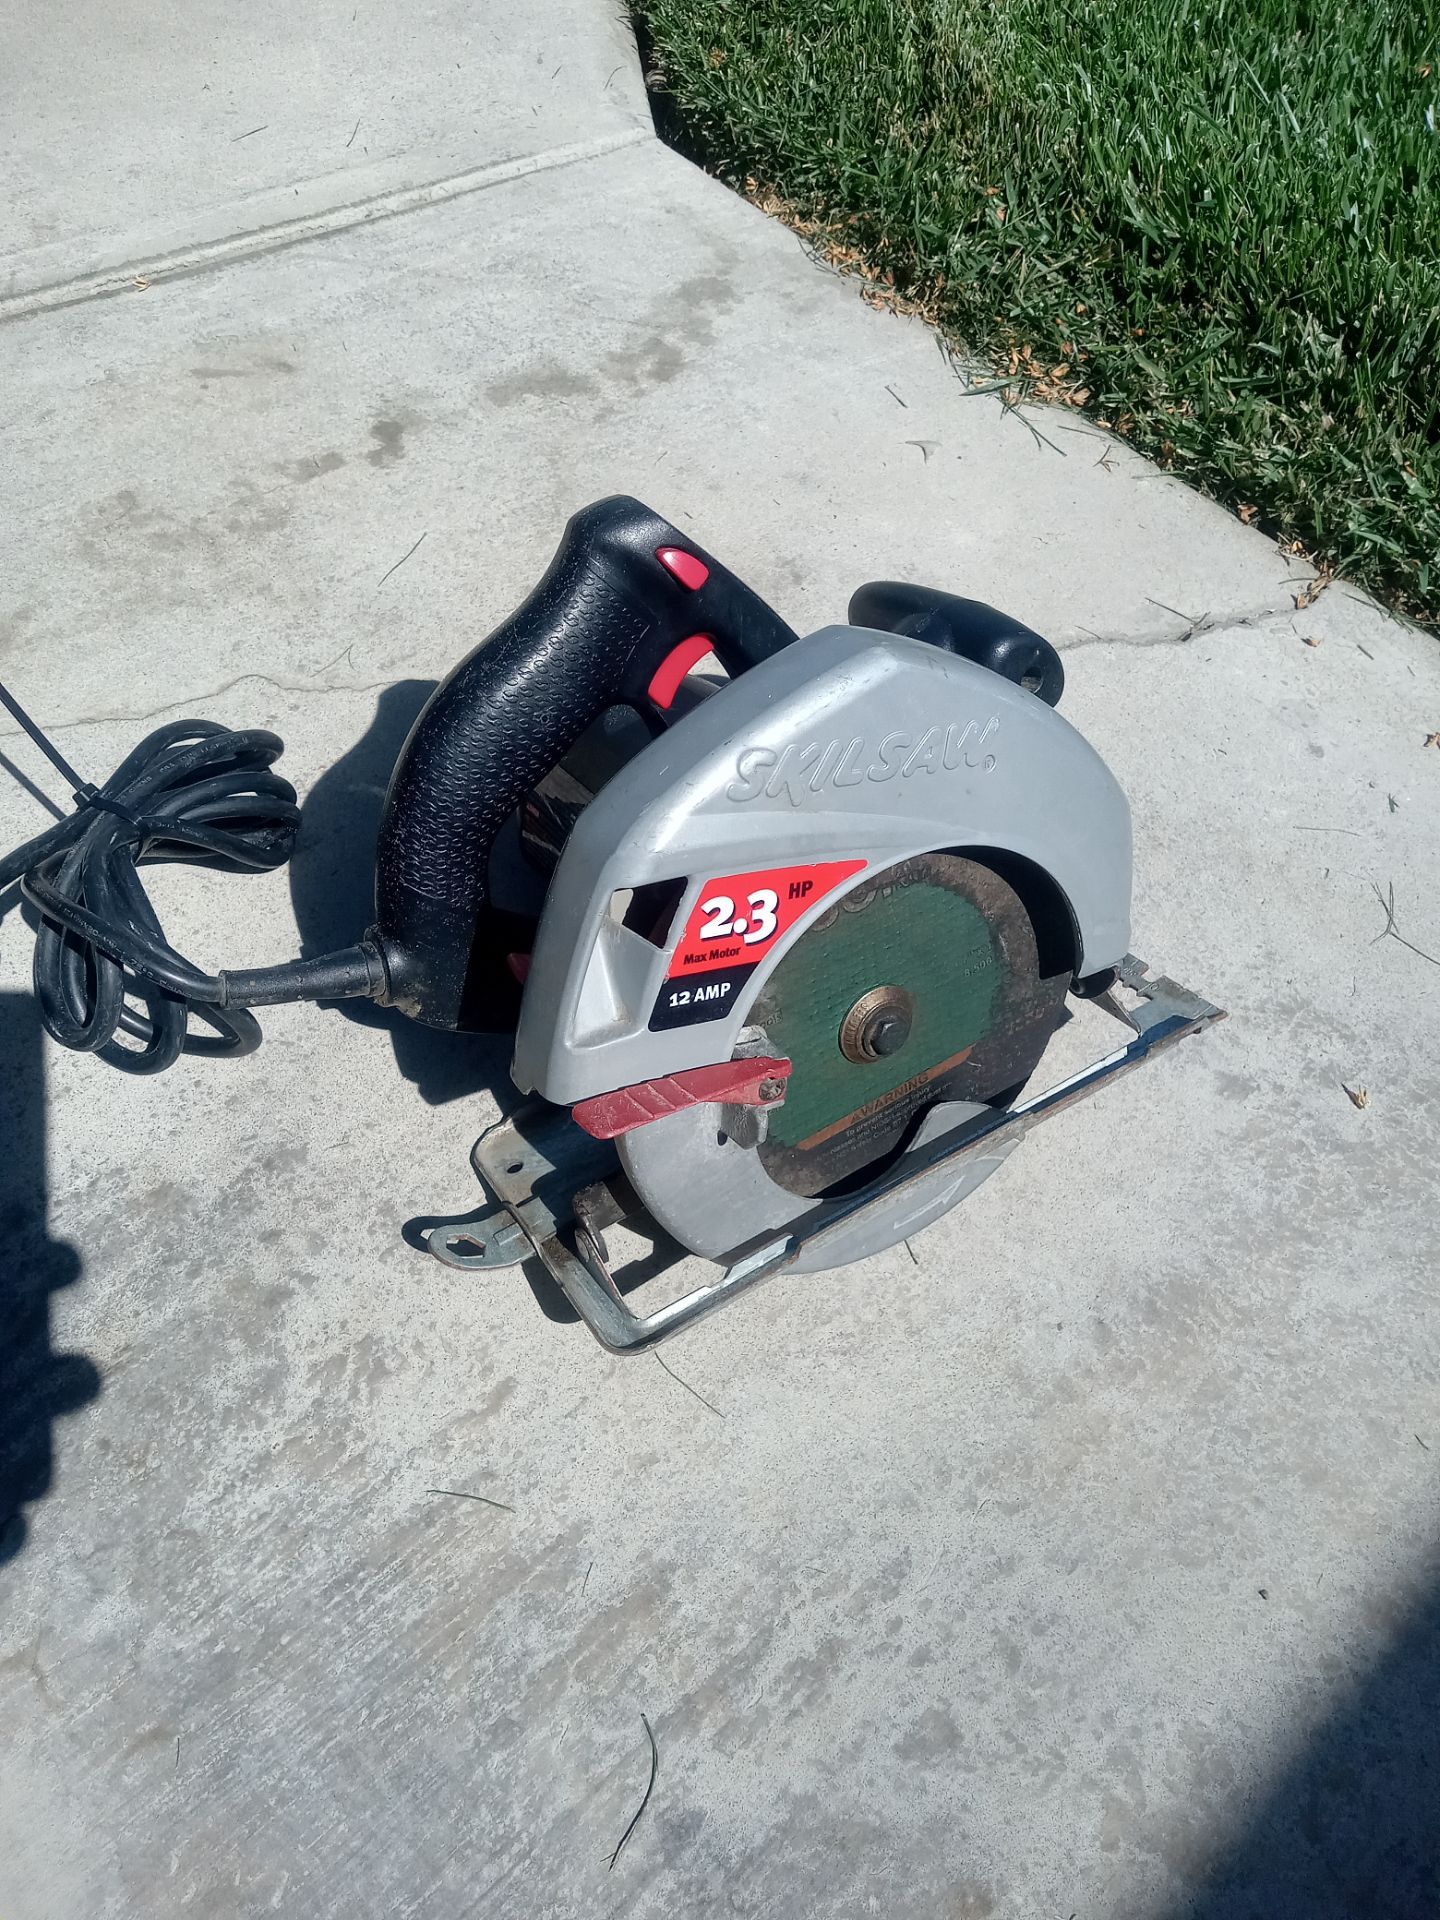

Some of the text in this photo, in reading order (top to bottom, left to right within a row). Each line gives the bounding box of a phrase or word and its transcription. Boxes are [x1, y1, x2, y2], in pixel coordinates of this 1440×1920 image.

[788, 879, 814, 900] HP
[699, 888, 780, 946] 2.3
[683, 946, 741, 966] Max Motor
[669, 982, 731, 1008] 12 AMP
[862, 1073, 930, 1116] WARNING
